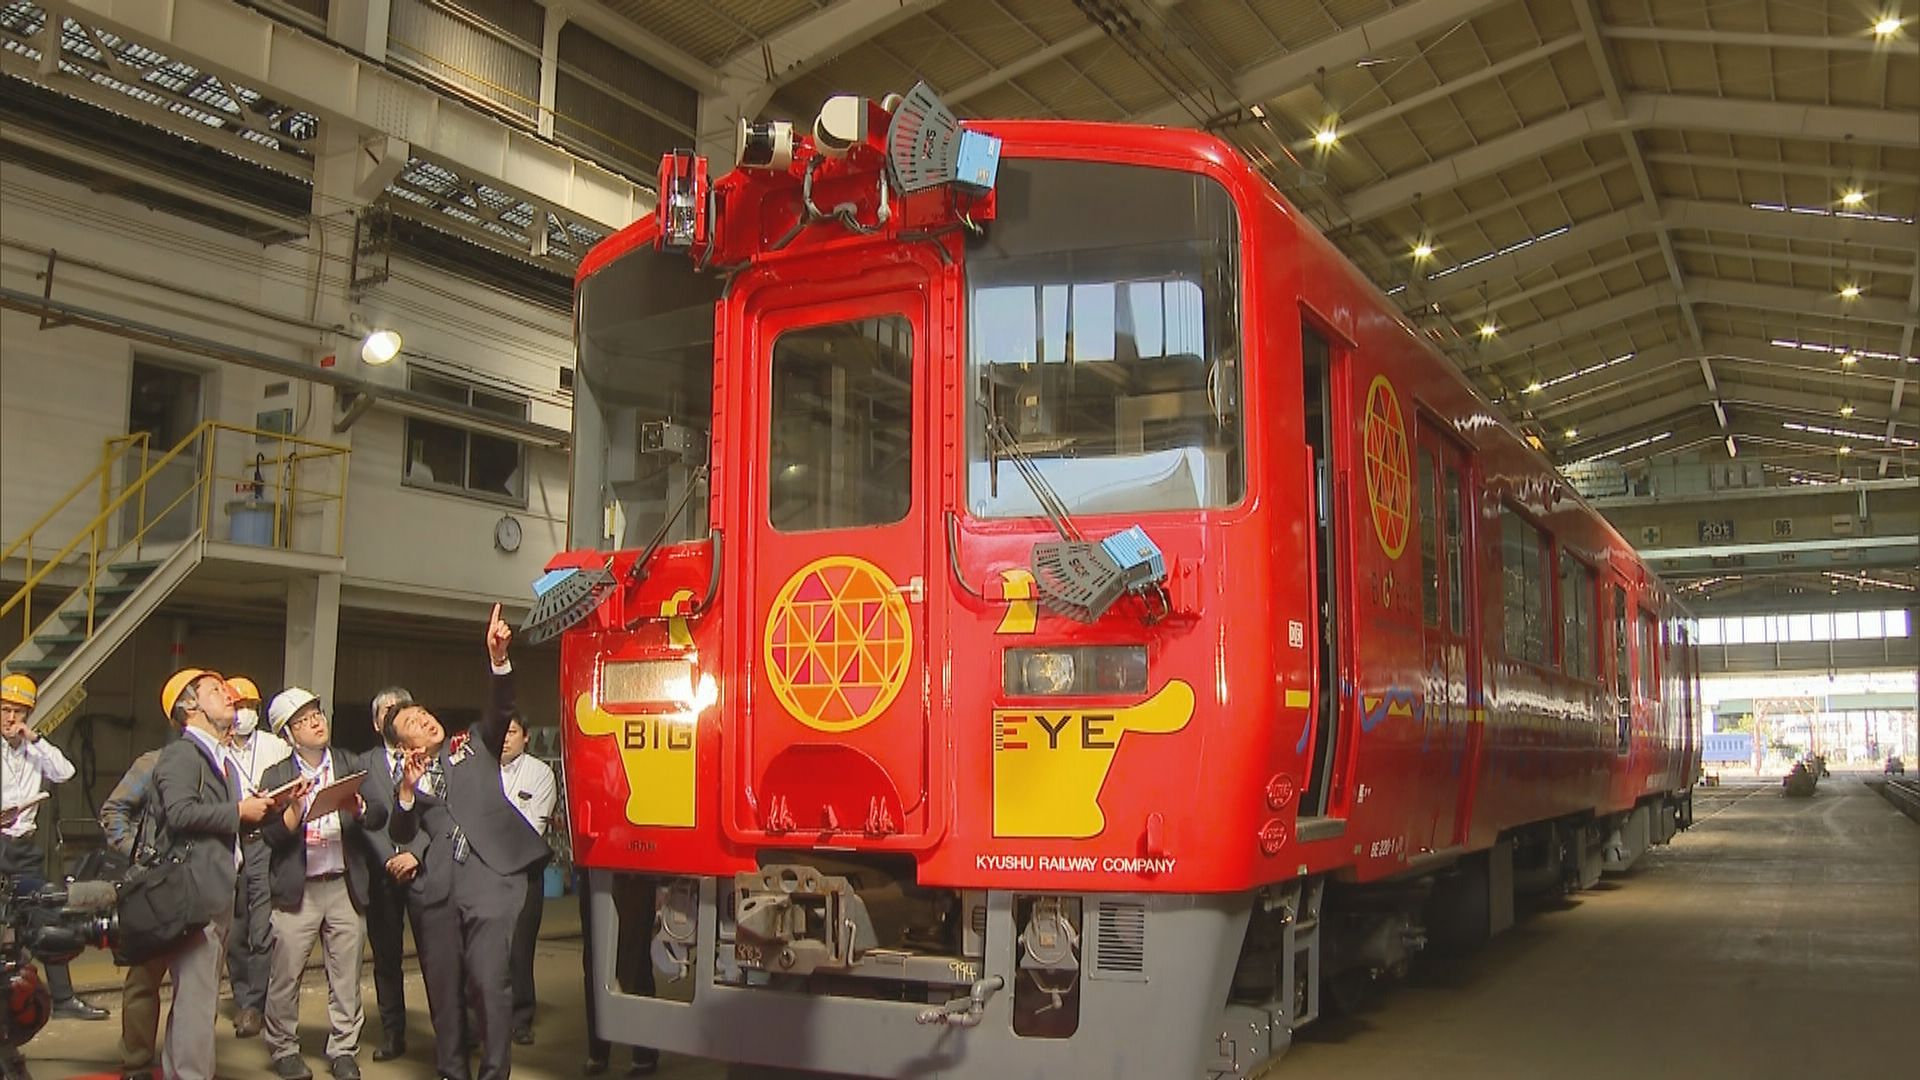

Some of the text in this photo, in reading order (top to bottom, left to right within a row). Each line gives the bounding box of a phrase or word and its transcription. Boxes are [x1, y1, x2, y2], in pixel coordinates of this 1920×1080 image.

[624, 719, 692, 750] BIG
[996, 714, 1115, 751] EYE
[976, 855, 1176, 874] KYUSHU RAILWAY COMPANY
[949, 961, 977, 982] 994
